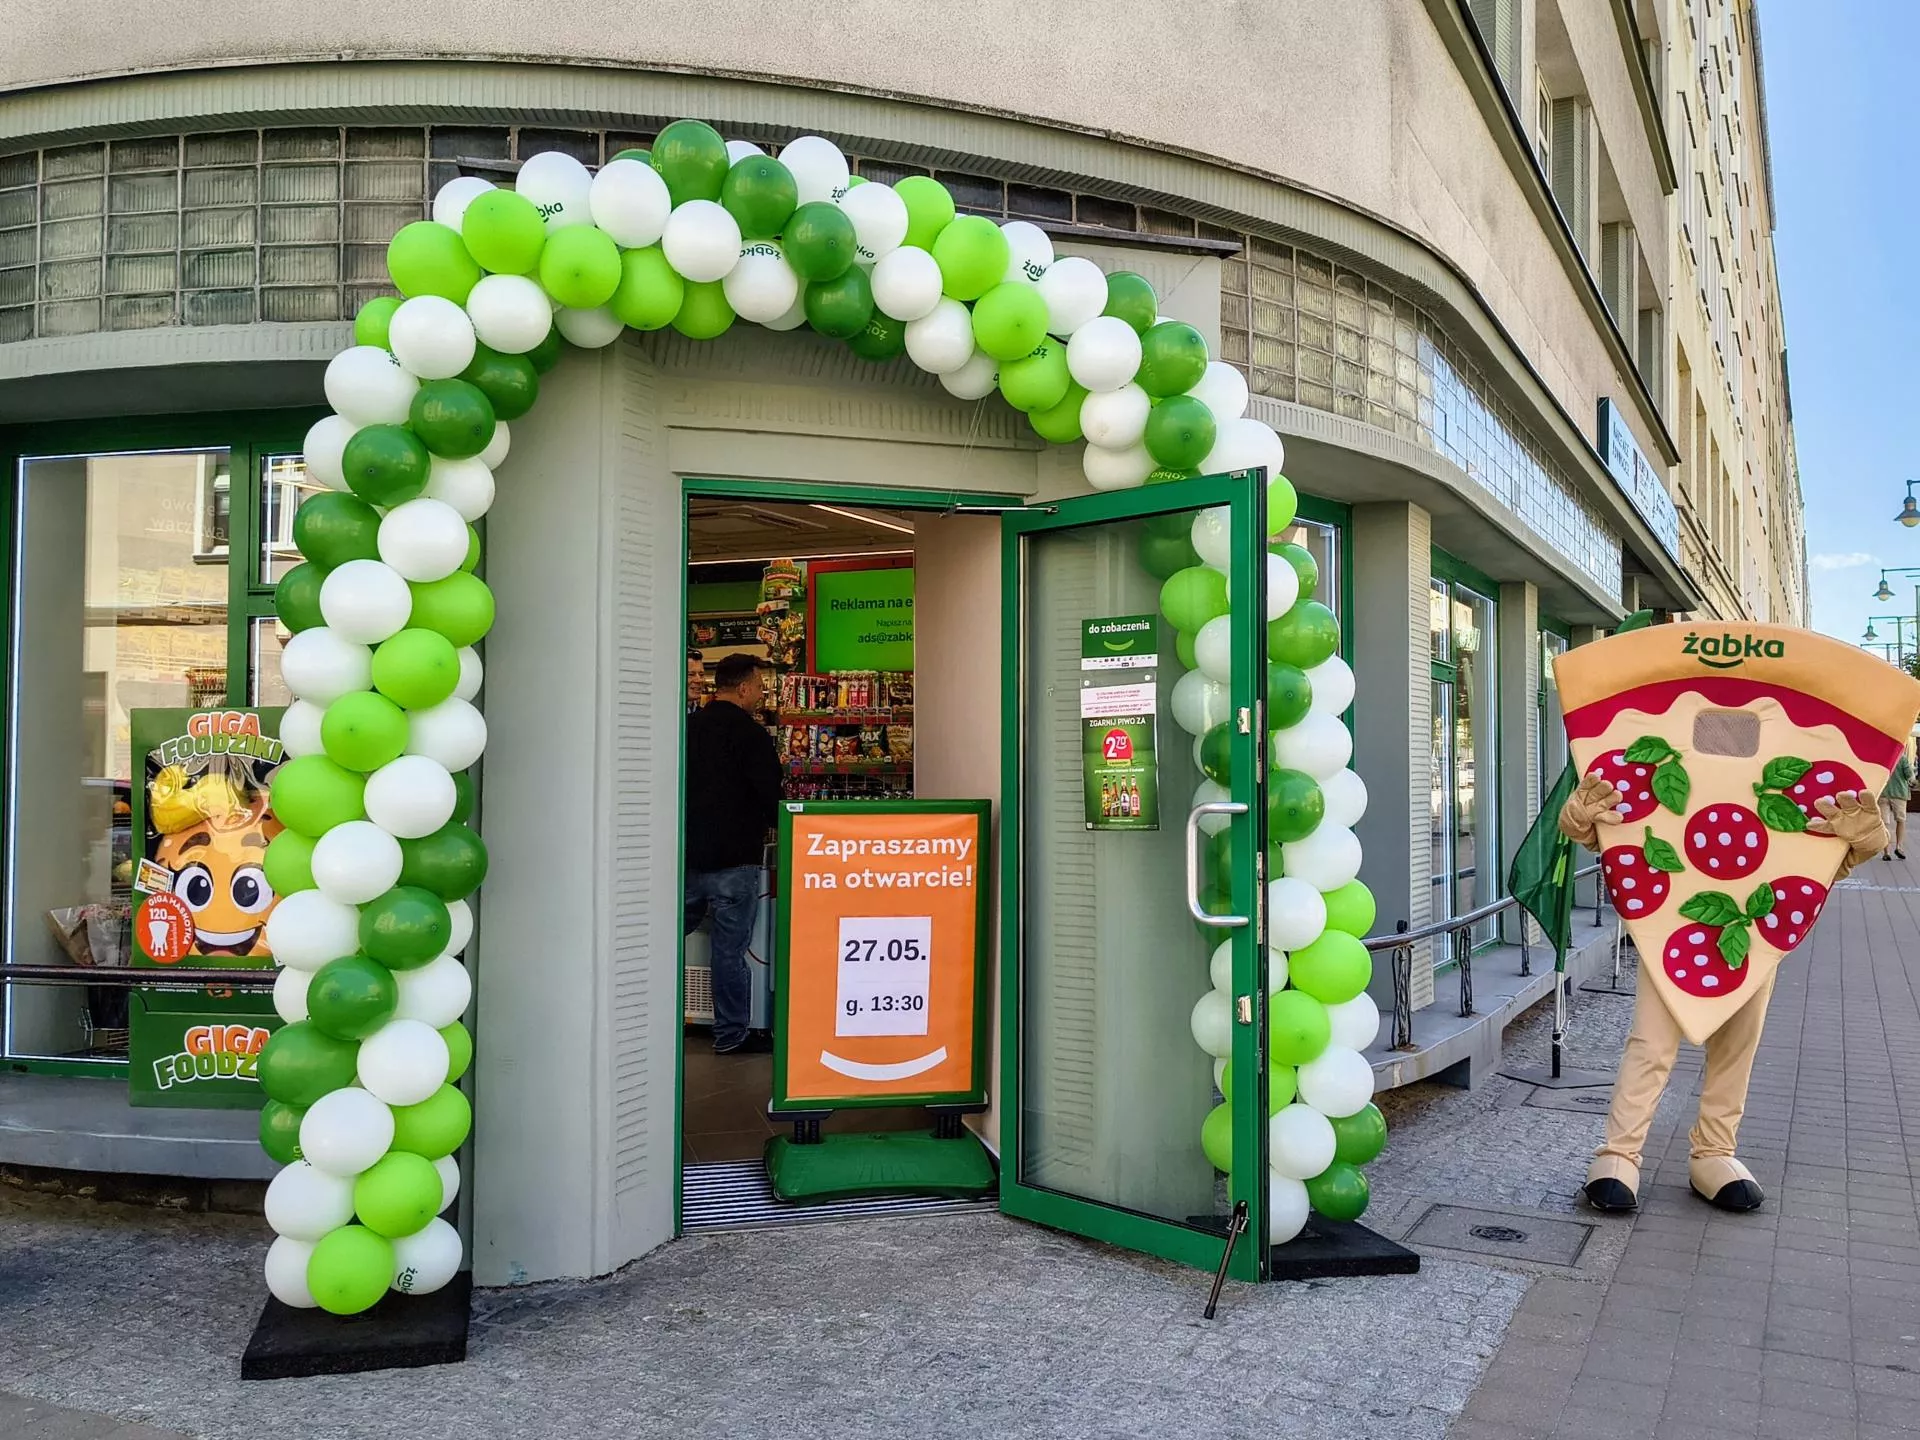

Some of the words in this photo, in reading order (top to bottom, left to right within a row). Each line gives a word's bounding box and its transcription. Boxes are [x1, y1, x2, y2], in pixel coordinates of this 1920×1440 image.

[535, 202, 564, 218] bka
[831, 597, 885, 611] Reklama
[887, 599, 903, 609] na
[857, 632, 913, 644] ads@zabk
[1088, 624, 1100, 634] do
[1101, 619, 1150, 633] zobaczenia
[1682, 632, 1785, 659] żabka
[187, 711, 260, 739] GIGA
[1089, 719, 1117, 728] ZGARNIJ
[1117, 717, 1136, 726] PIWO
[1136, 716, 1146, 725] ZA
[160, 733, 283, 766] FOODZIKI
[806, 833, 972, 862] Zapraszamy
[803, 872, 837, 889] na
[844, 865, 972, 889] otwarcie!
[148, 907, 168, 921] 120
[148, 894, 169, 907] GIGA
[169, 896, 192, 945] MASKOTKA
[844, 939, 927, 962] 27.05.
[846, 999, 864, 1016] g.
[871, 995, 924, 1011] 13:30
[184, 1024, 271, 1056] GIGA
[153, 1051, 260, 1090] FOODZ
